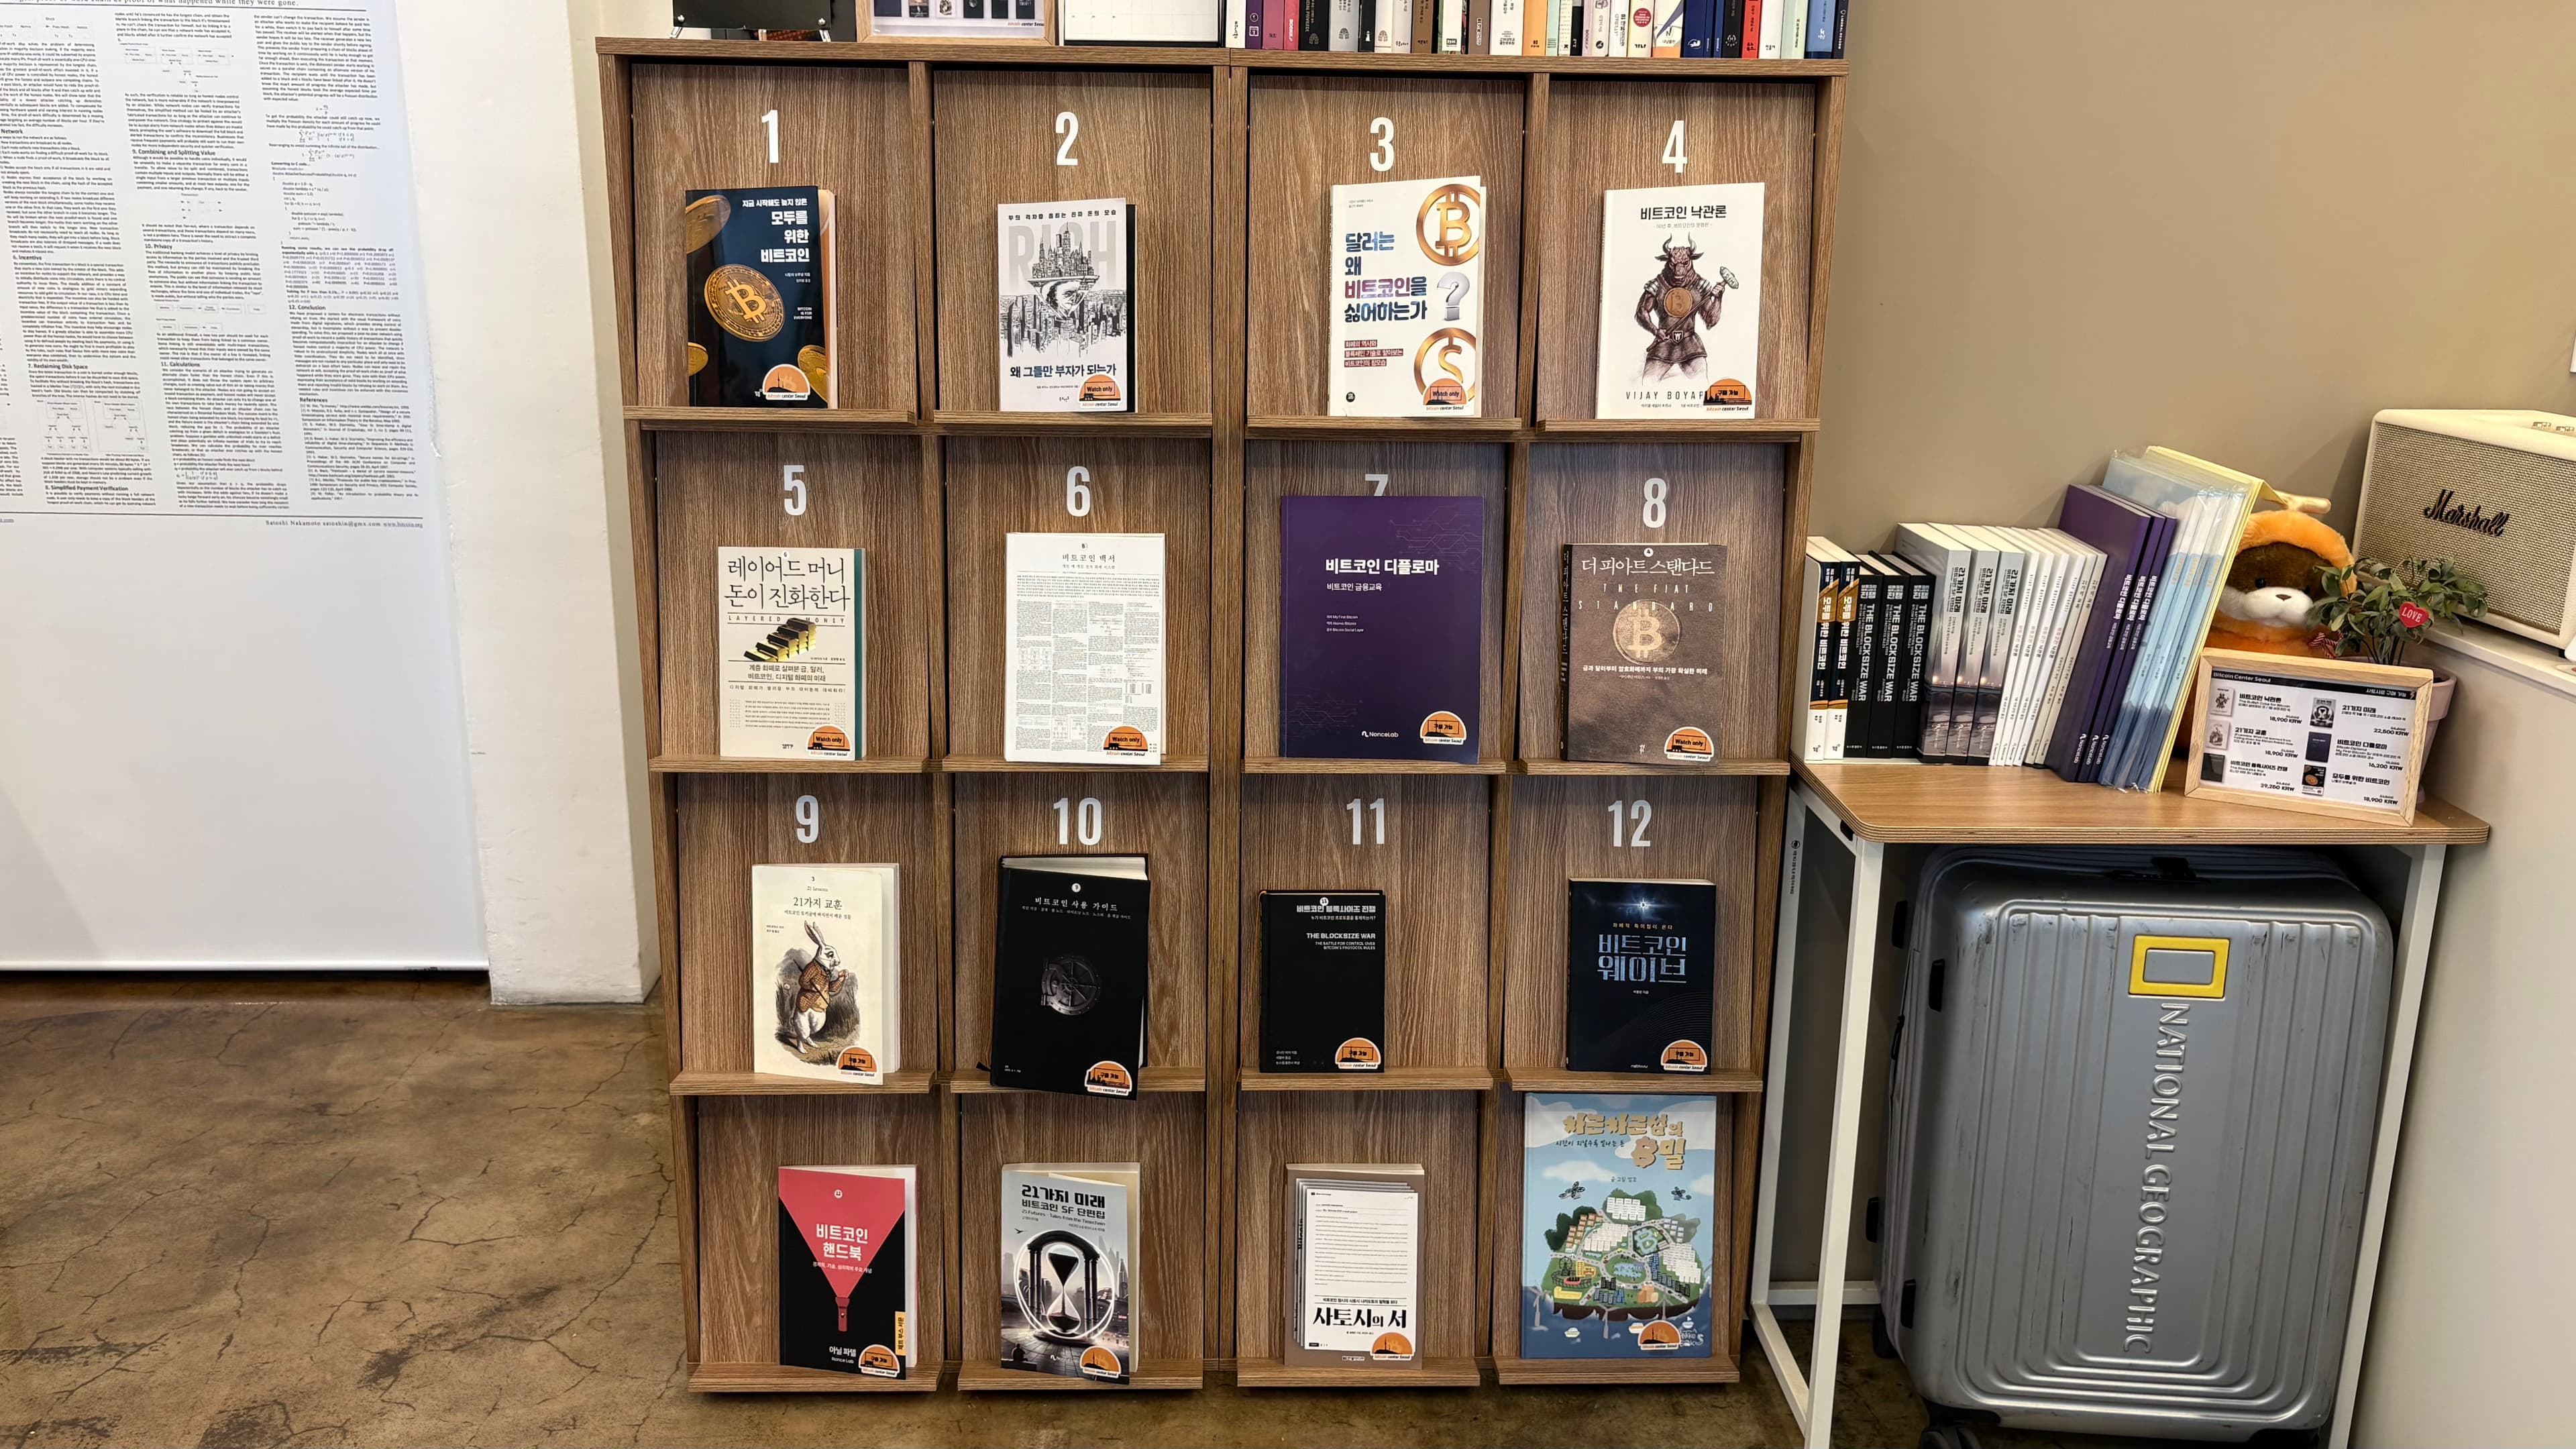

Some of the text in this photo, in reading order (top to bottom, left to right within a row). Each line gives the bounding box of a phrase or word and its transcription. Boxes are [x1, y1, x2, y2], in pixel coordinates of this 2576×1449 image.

[761, 109, 779, 163] 1
[1055, 111, 1079, 166] 2
[1370, 117, 1395, 172] 3
[1662, 120, 1688, 173] 4
[742, 199, 755, 207] 지금
[1640, 205, 1727, 220] 비트코인 낙관론
[771, 210, 808, 225] 모두를
[784, 229, 809, 244] 위한
[1345, 231, 1395, 252] 달러는
[760, 248, 810, 263] 비트코인
[1344, 256, 1362, 276] 왜
[1344, 276, 1427, 299] 비트코인을
[1344, 300, 1428, 323] 싫어하는가
[1010, 363, 1117, 378] 왜 그들만 부자가 되는가
[1625, 391, 1658, 400] VIJAY
[784, 465, 807, 516] 5
[1066, 466, 1091, 517] 6
[1364, 474, 1389, 496] 7
[1643, 478, 1667, 528] 8
[2424, 488, 2510, 536] Marshall
[1062, 553, 1115, 563] 비트코인 백서
[1325, 558, 1440, 576] 비트코인 디플로마
[1581, 557, 1715, 577] 더 피아트 스탠다드
[728, 555, 844, 584] 레이어드 머니
[1327, 583, 1383, 592] 비트코인 금융교육
[1603, 583, 1688, 594] THE FIAT
[1953, 567, 1966, 612] 21가지 미래
[1980, 568, 1993, 613] 21가지 미래
[2004, 570, 2019, 614] 21가지 미래
[2120, 574, 2133, 597] 비트코인
[2134, 576, 2146, 598] 비트코인
[2145, 576, 2157, 598] 비트코인
[724, 584, 851, 612] 돈이 진화한다
[1578, 600, 1713, 612] STANDARD
[1866, 604, 1875, 623] THE
[2402, 607, 2422, 623] LOVE
[1817, 596, 1831, 669] 모두를 위한 비트코인
[1838, 596, 1852, 669] 모두를 위한 비트코인
[1860, 625, 1874, 679] BLOCKSIZE
[1884, 604, 1901, 702] THE BLOCKSIZE WAR
[1909, 604, 1927, 702] THE BLOCKSIZE WAR
[1858, 680, 1868, 701] WAR
[2239, 693, 2263, 701] 비트코인
[2235, 727, 2254, 735] 21가지
[2337, 739, 2387, 750] 비트코인 디플로마
[2365, 777, 2390, 786] 비트코인
[796, 794, 819, 843] 9
[1053, 798, 1102, 845] 10
[1346, 798, 1385, 845] 11
[1607, 800, 1652, 847] 12
[794, 897, 843, 910] 21가지 교훈
[1035, 897, 1118, 912] 비트코인 사용 가이드
[1296, 905, 1324, 913] 비트코인
[1326, 905, 1360, 913] 블록사이즈
[1598, 934, 1686, 957] 비트코인
[1597, 955, 1687, 983] 웨이브
[2145, 1002, 2191, 1159] NATIONAL
[1022, 1184, 1105, 1209] 21가지 미래
[1022, 1199, 1106, 1220] 비트코인 SF 단편집
[816, 1223, 868, 1244] 비트코인
[822, 1241, 862, 1262] 핸드북
[2123, 1165, 2174, 1354] GEOGRAPHIC
[1313, 1307, 1407, 1328] 사토시의 서
[898, 1328, 904, 1339] 부스
[828, 1346, 857, 1357] 아닐 파텔
